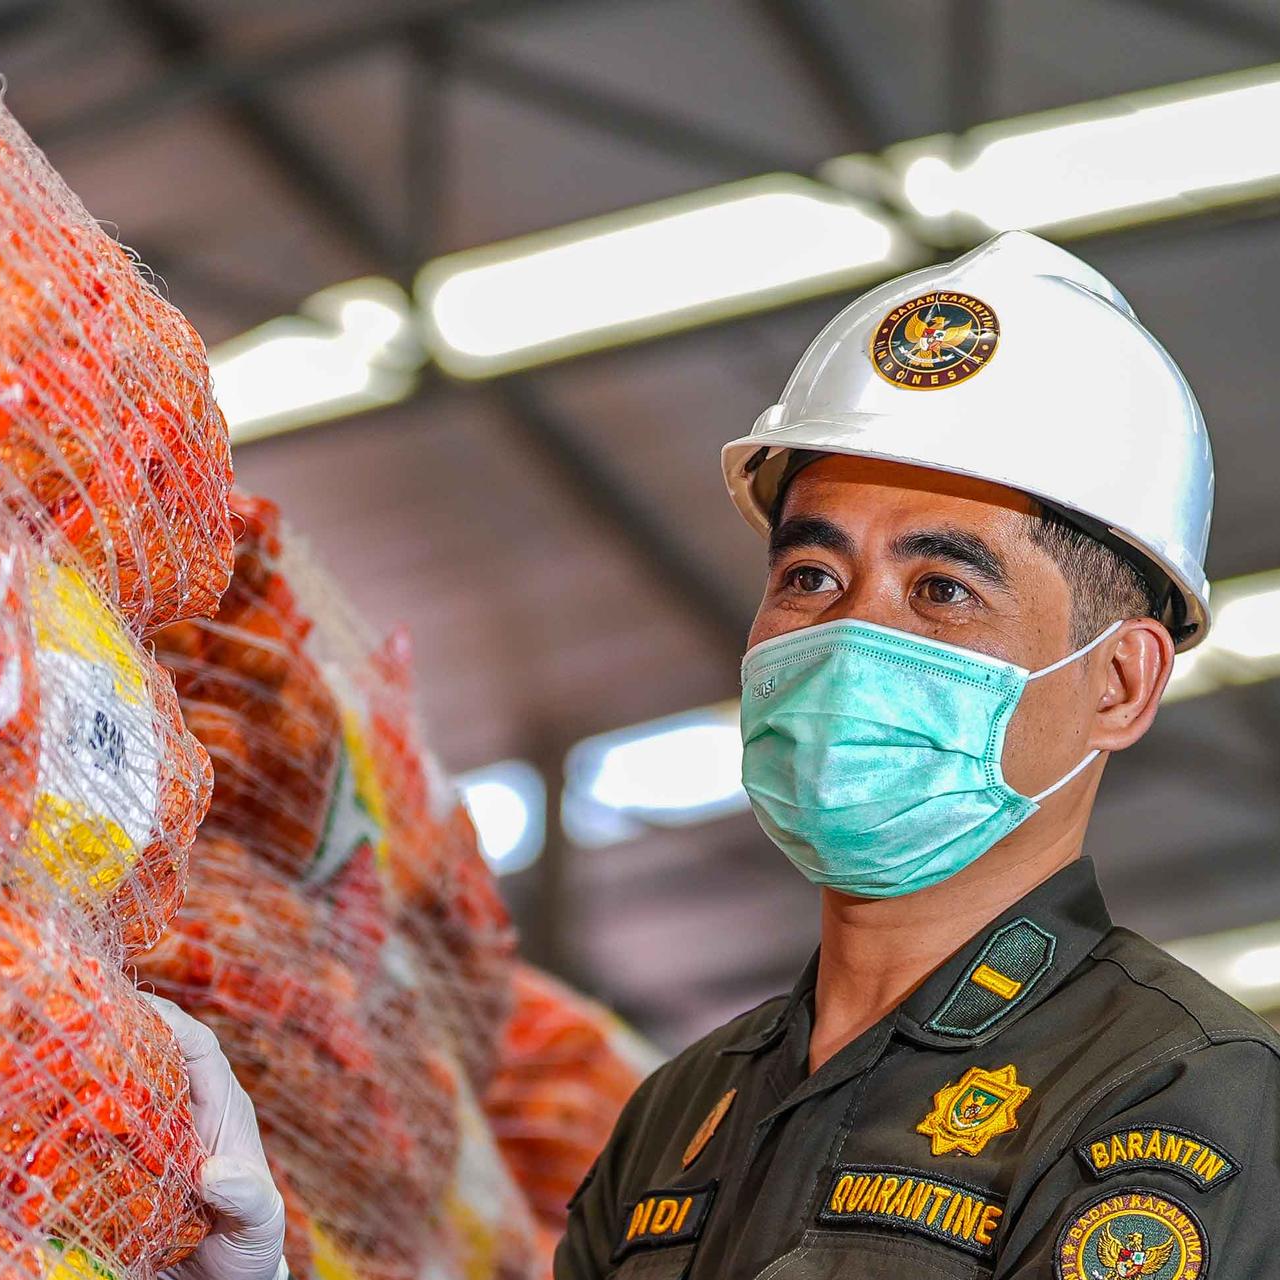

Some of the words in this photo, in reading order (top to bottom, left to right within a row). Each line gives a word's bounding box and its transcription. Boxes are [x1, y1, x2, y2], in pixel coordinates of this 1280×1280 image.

[890, 295, 935, 321] BADAN
[939, 294, 996, 336] KARANTIN
[876, 340, 984, 385] INDONESIA
[750, 676, 775, 699] ensi
[1091, 1129, 1225, 1181] BARANTIN
[831, 1174, 1003, 1246] QUARANTINE
[1071, 1196, 1124, 1240] BADAN
[1129, 1194, 1202, 1263] KARANTINA
